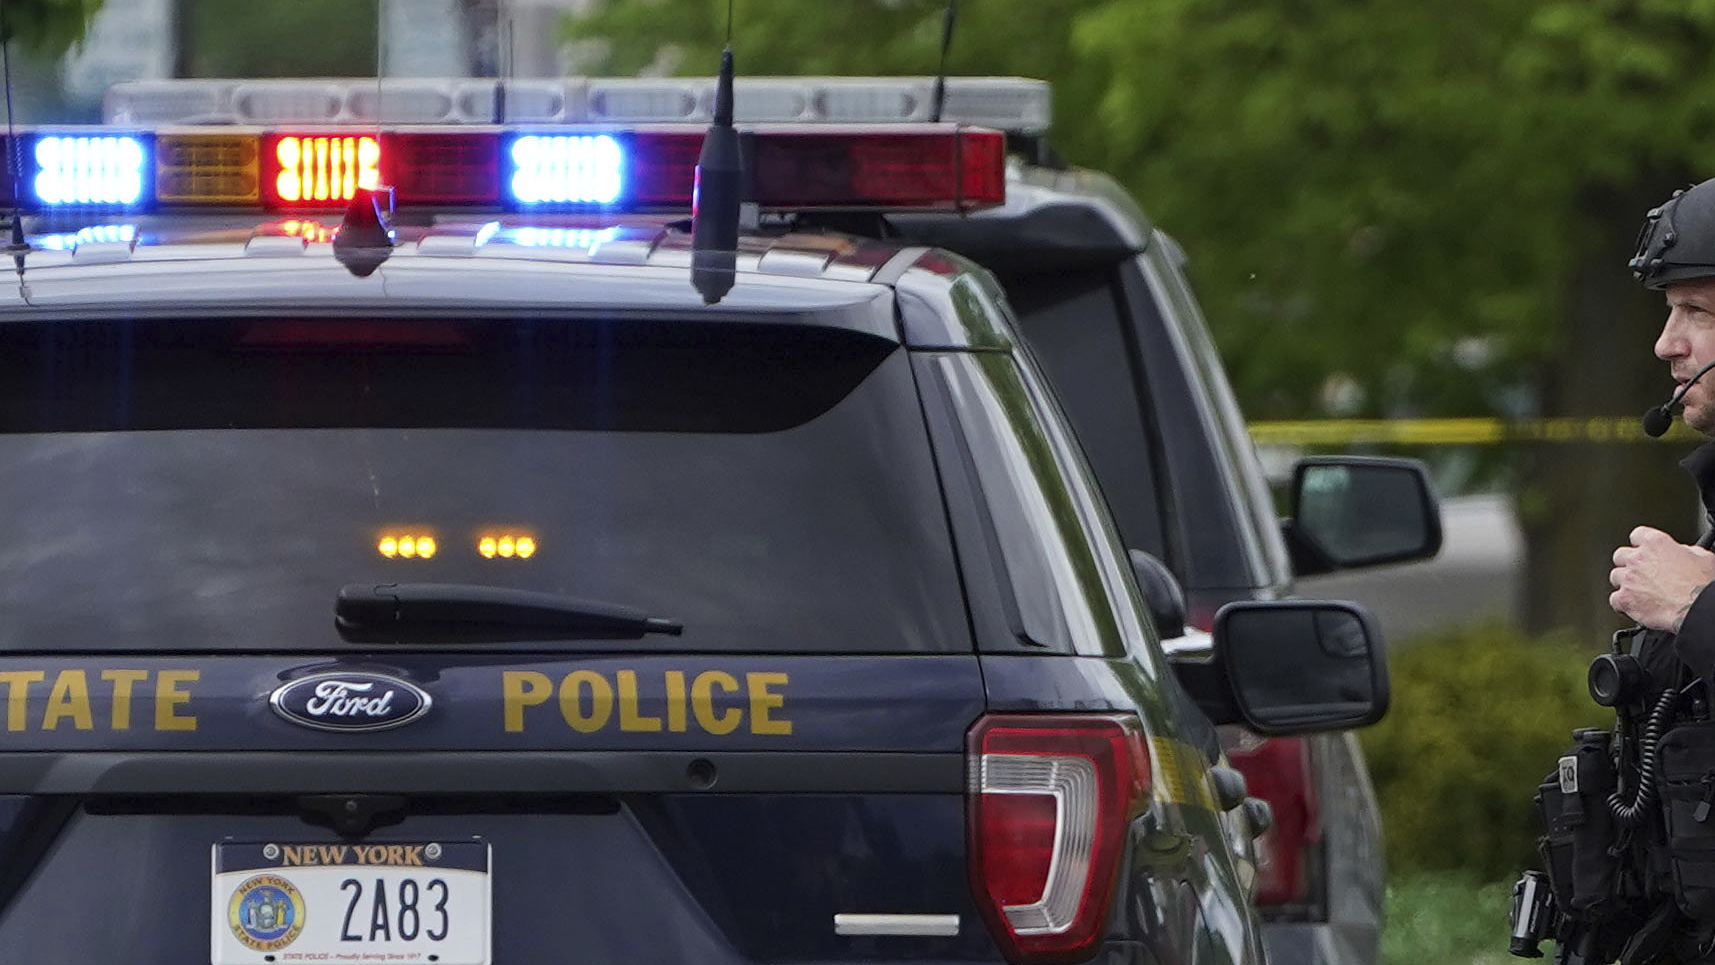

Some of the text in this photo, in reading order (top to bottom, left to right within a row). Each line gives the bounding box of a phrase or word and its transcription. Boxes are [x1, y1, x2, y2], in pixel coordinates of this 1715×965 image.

[305, 680, 394, 718] Ford
[502, 669, 793, 736] POLICE
[281, 844, 424, 867] NEW YORK
[239, 876, 296, 895] NEW YORK
[339, 877, 450, 943] 2A83
